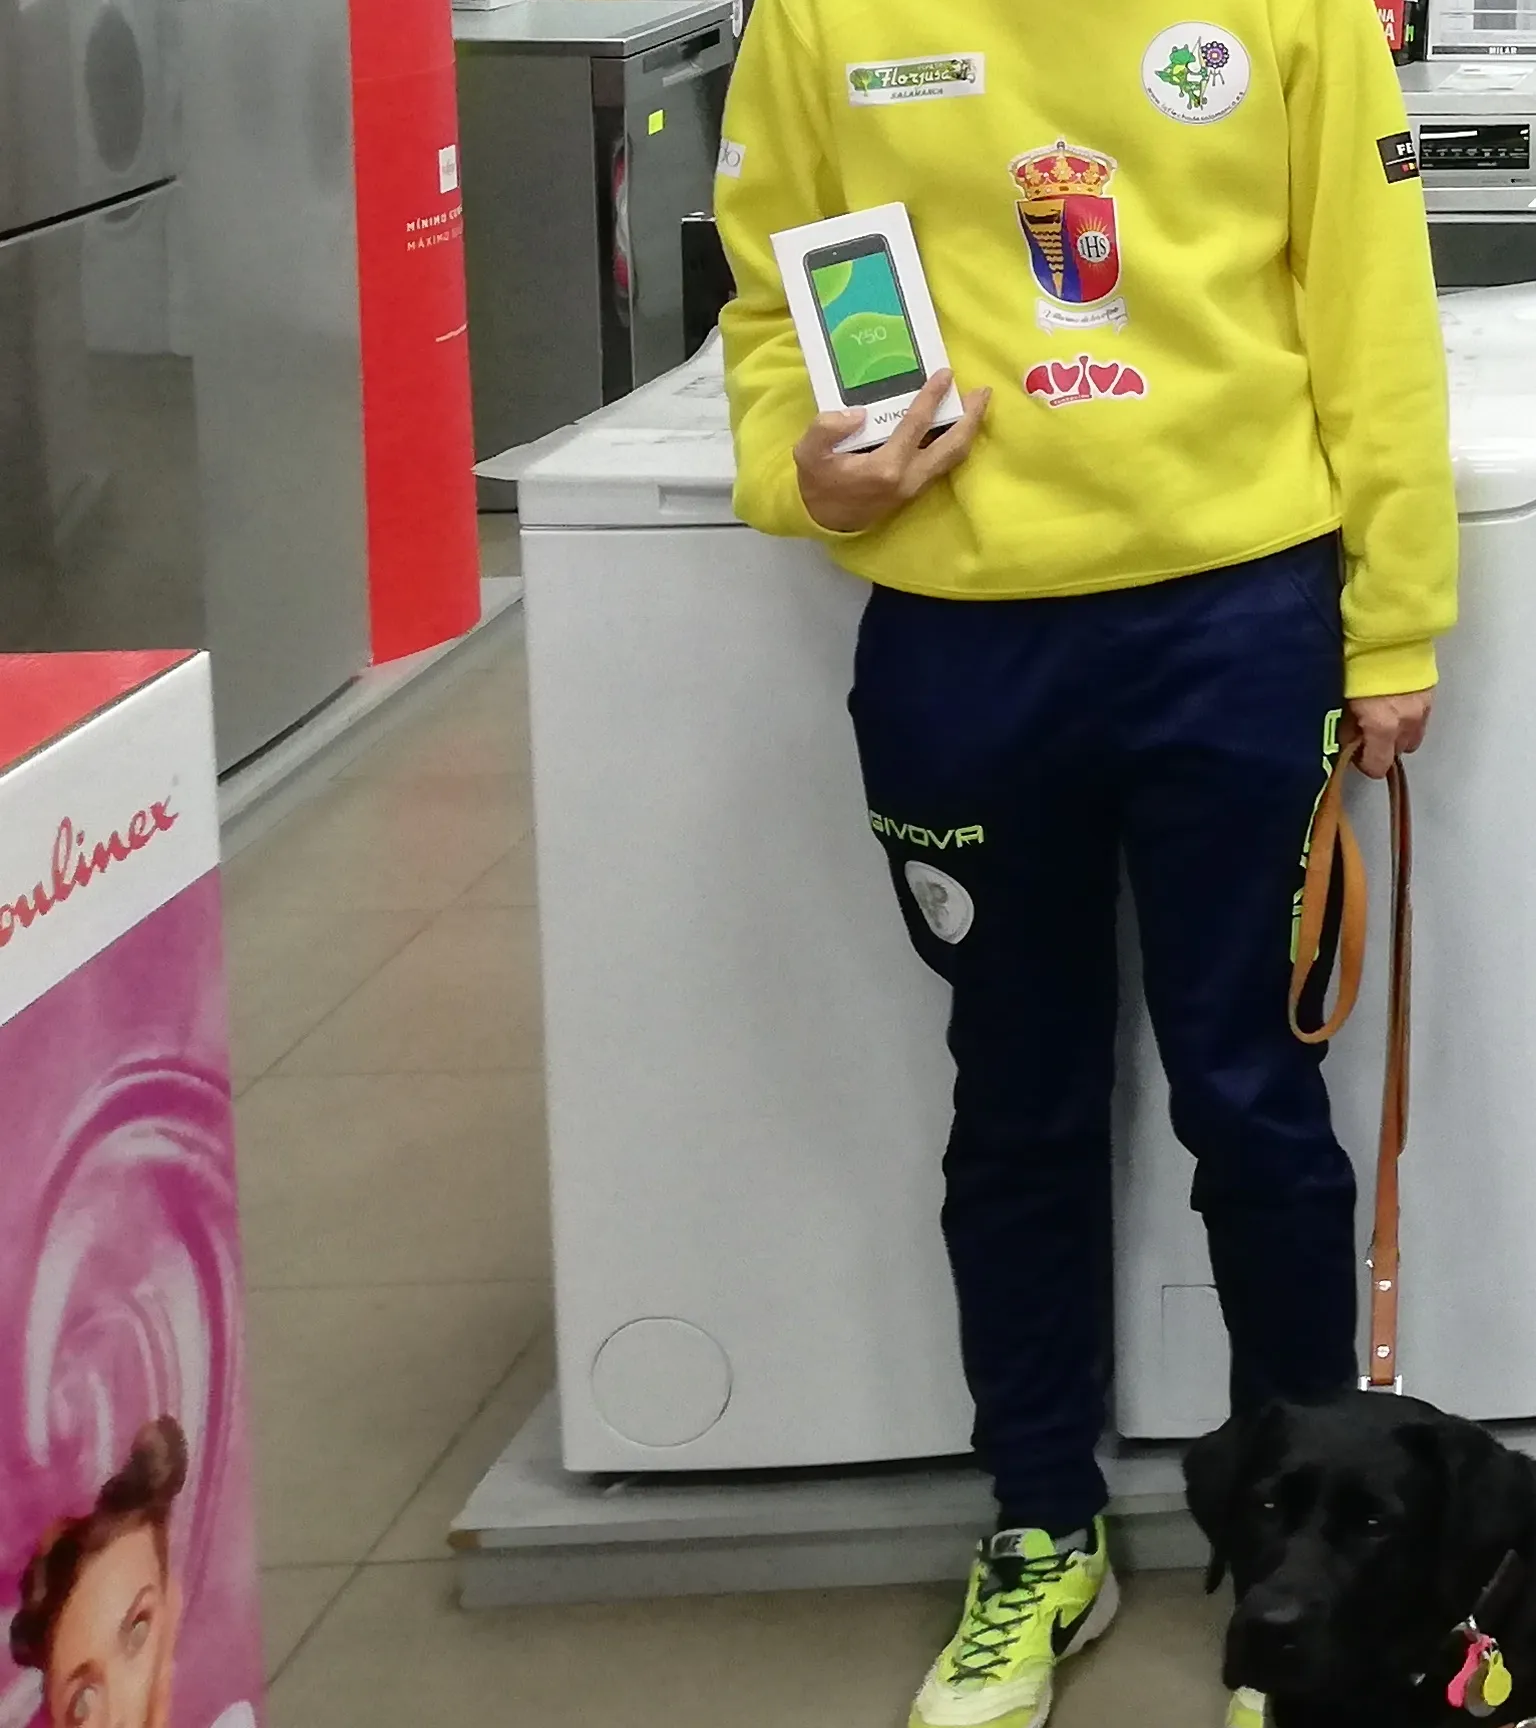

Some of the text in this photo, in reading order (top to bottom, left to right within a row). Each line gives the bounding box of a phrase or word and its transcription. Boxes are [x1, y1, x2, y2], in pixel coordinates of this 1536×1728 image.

[1489, 46, 1518, 55] MILAR
[890, 87, 944, 100] SALAMANCA
[851, 325, 887, 347] Y50
[869, 809, 984, 851] GIVOVA
[0, 794, 180, 948] oulinex
